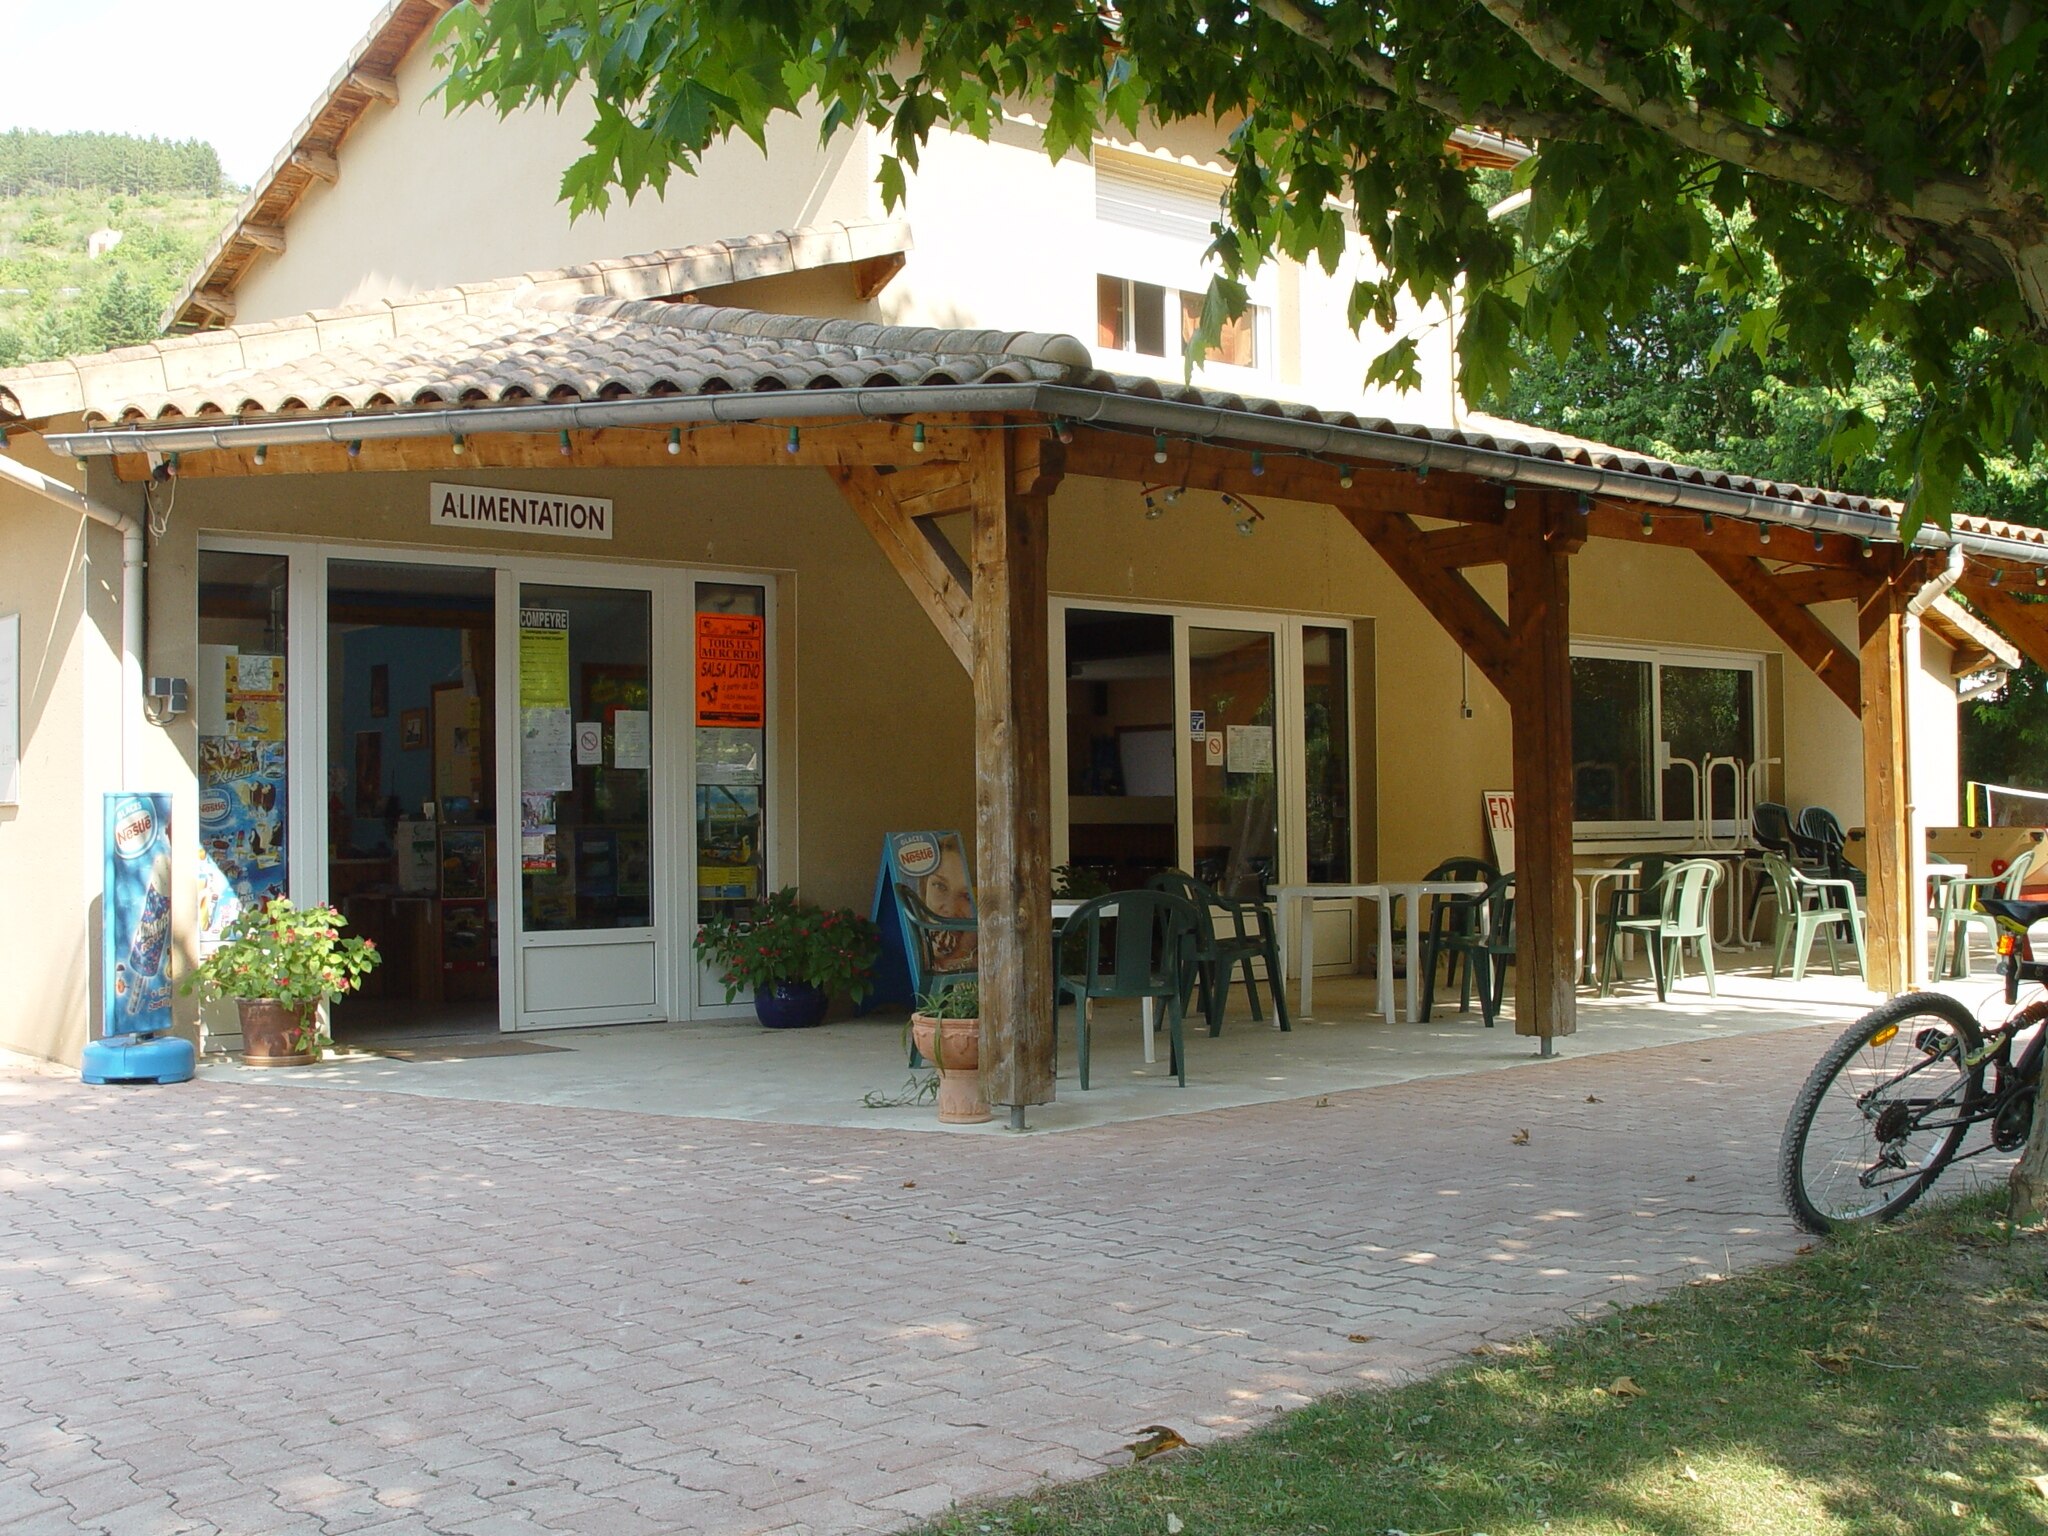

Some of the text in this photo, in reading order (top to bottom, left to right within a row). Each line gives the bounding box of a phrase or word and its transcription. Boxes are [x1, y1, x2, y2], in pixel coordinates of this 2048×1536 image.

[441, 491, 604, 531] ALIMENTATION
[520, 610, 567, 629] COMPEYRE
[709, 639, 753, 650] TOUS LES
[701, 648, 759, 660] MERCREDI
[701, 661, 760, 679] SALSA LATINO
[117, 815, 152, 845] Nestlé
[900, 836, 924, 846] GLACES
[901, 847, 934, 865] Nestlé
